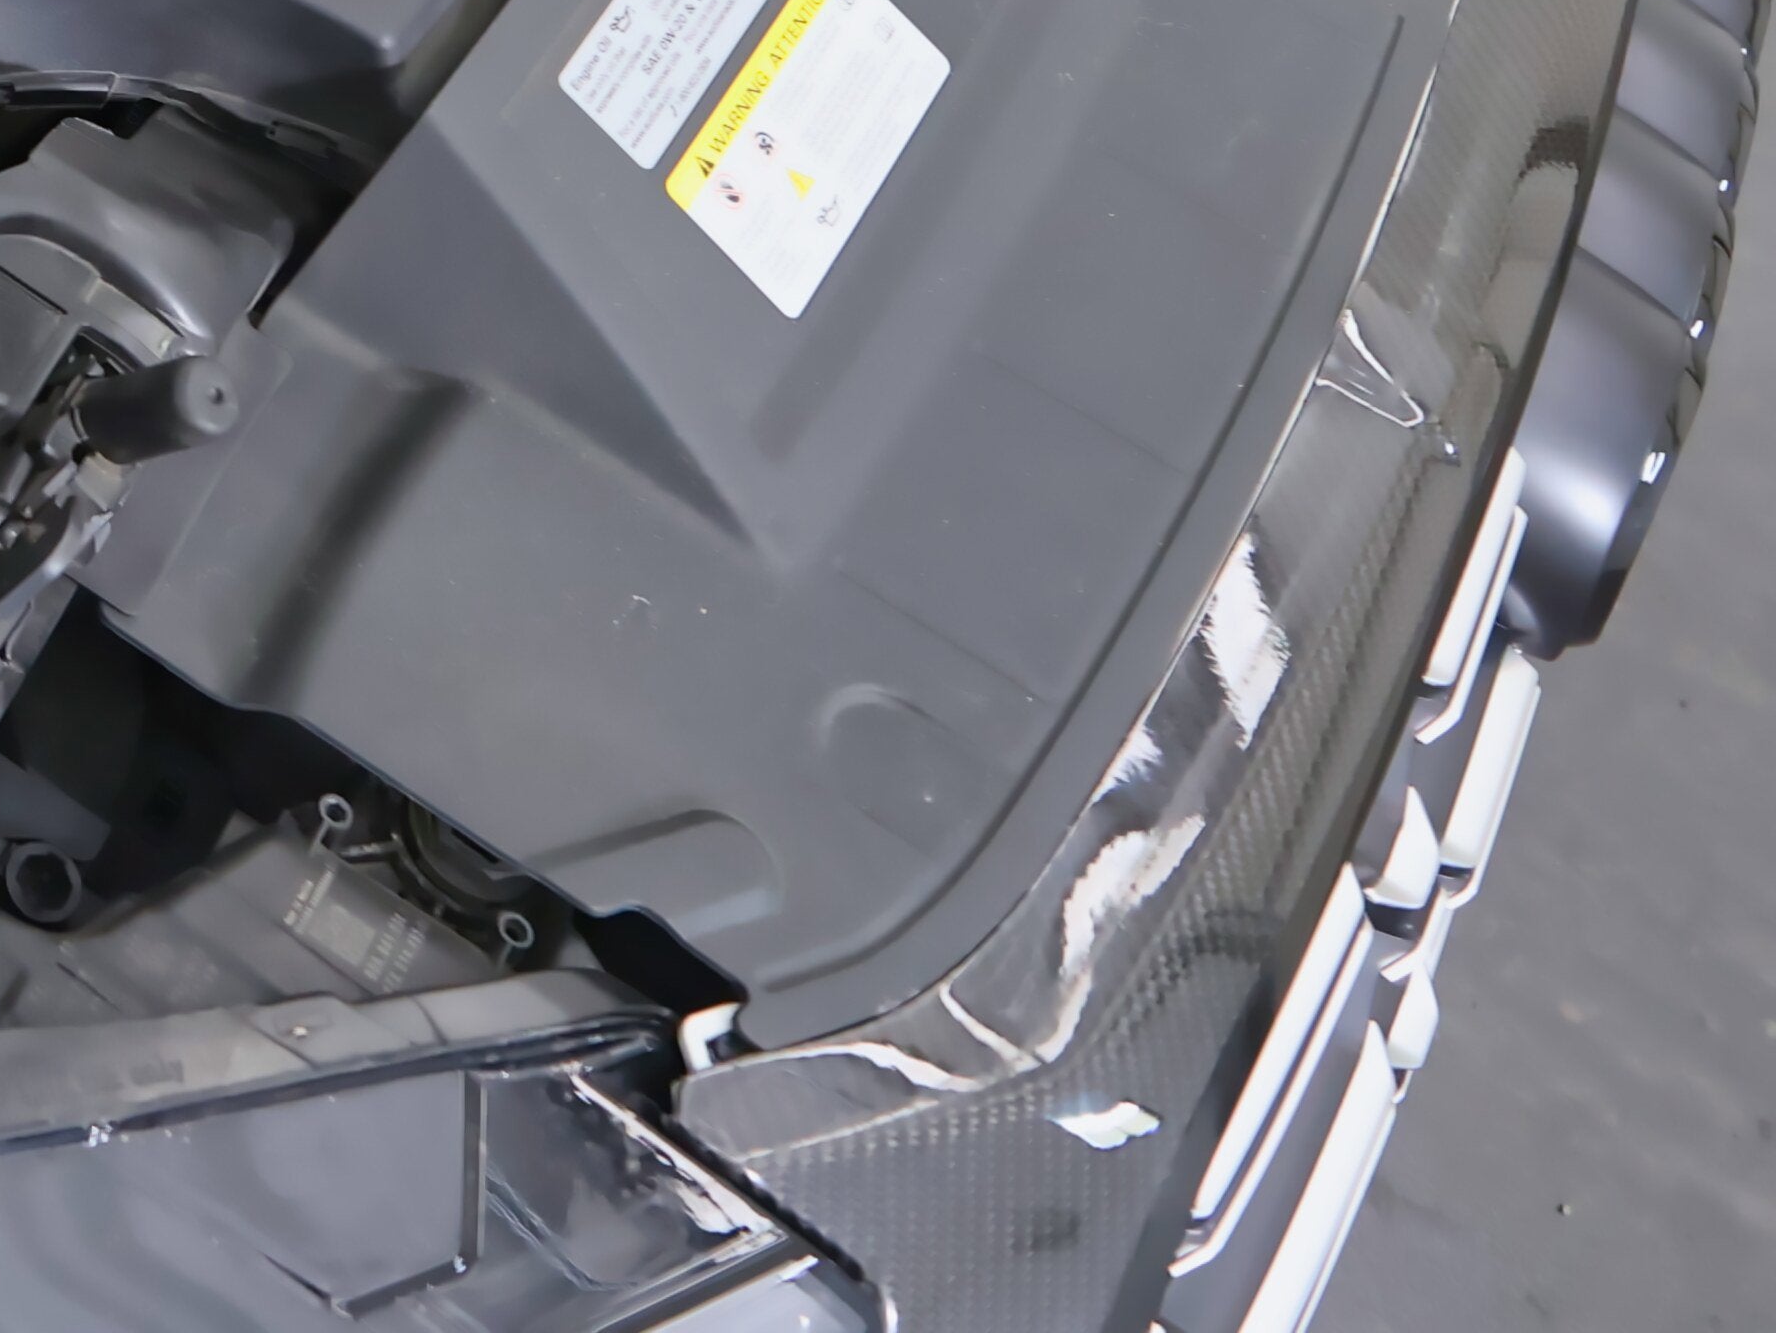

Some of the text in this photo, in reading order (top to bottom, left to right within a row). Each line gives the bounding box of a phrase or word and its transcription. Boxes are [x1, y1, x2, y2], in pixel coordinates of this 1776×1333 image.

[569, 32, 612, 93] Engine Oil
[638, 45, 662, 75] SAE
[707, 68, 771, 155] WARNING
